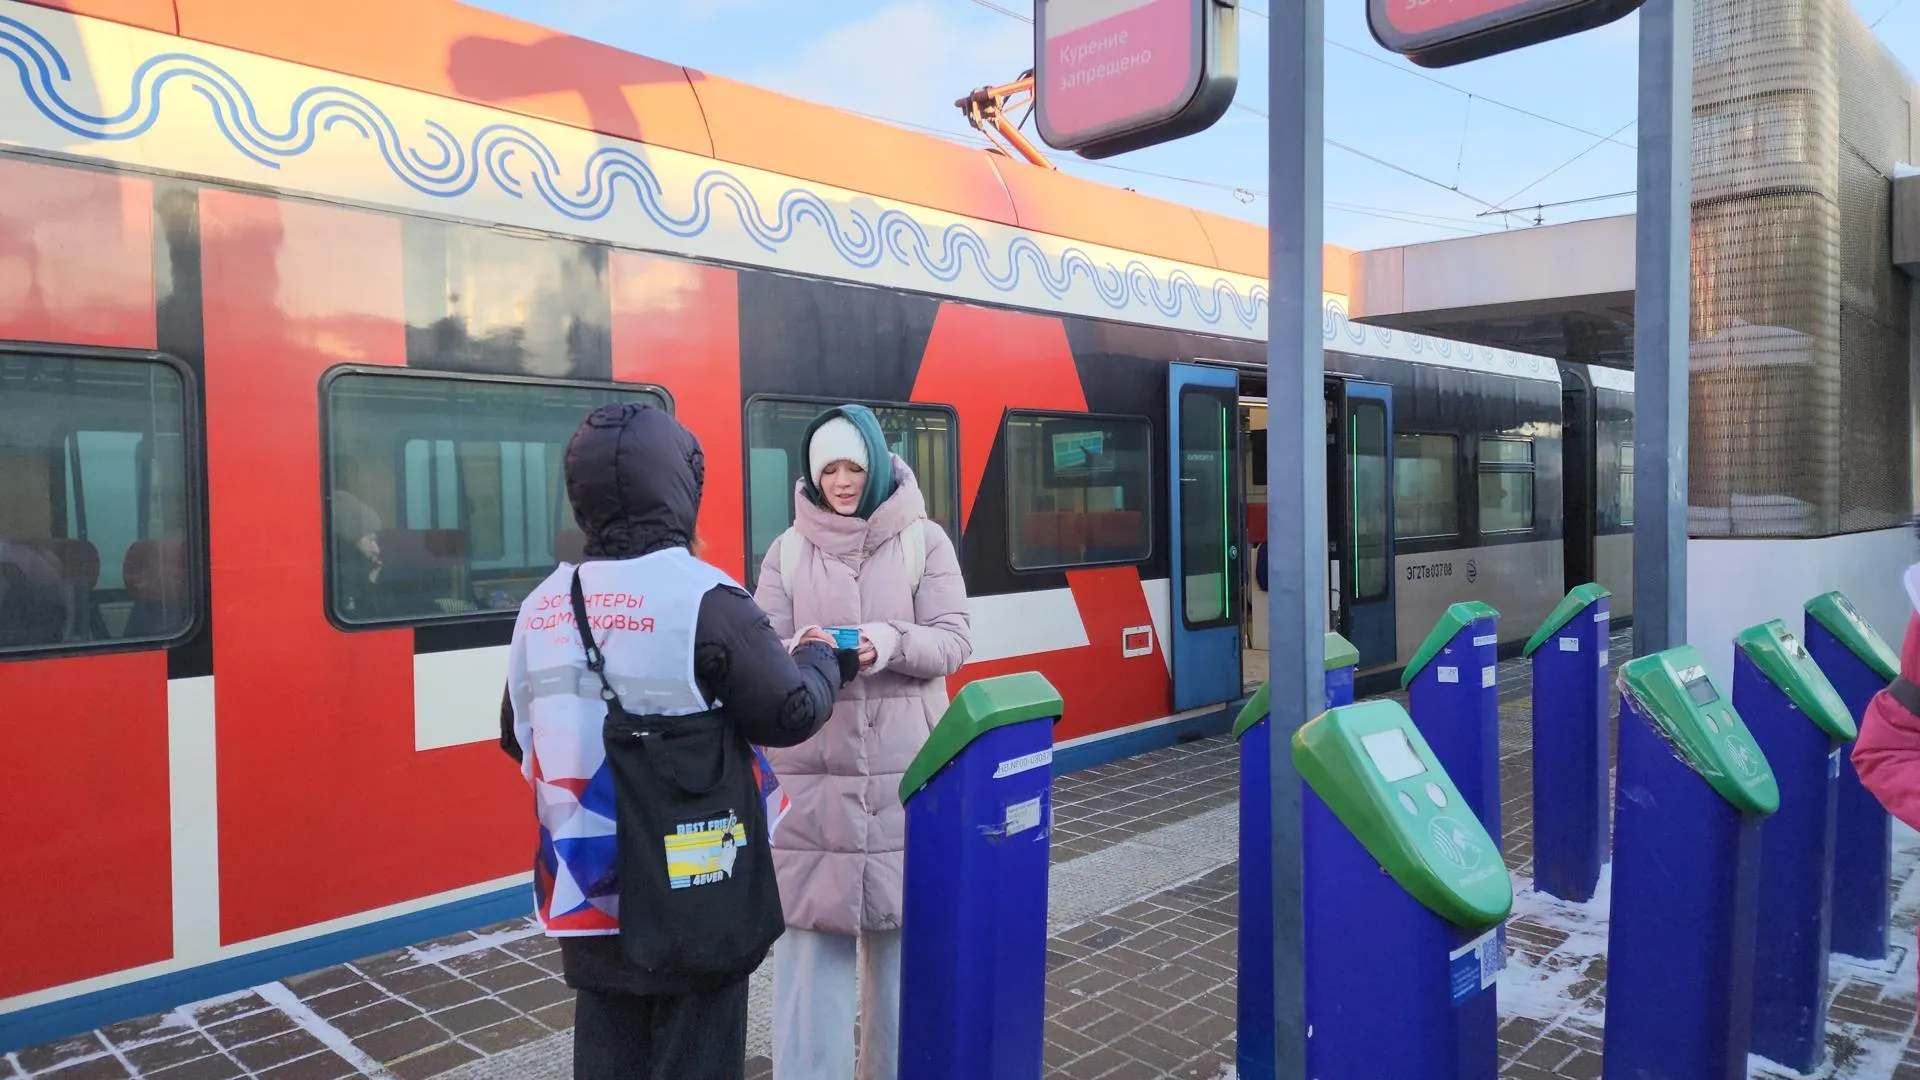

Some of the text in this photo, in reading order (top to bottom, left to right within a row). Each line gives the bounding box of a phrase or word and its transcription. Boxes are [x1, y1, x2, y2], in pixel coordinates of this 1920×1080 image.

[1060, 30, 1128, 66] Курение
[1060, 50, 1152, 90] запрещено
[707, 815, 738, 832] FRIED
[693, 870, 724, 886] 4EVER
